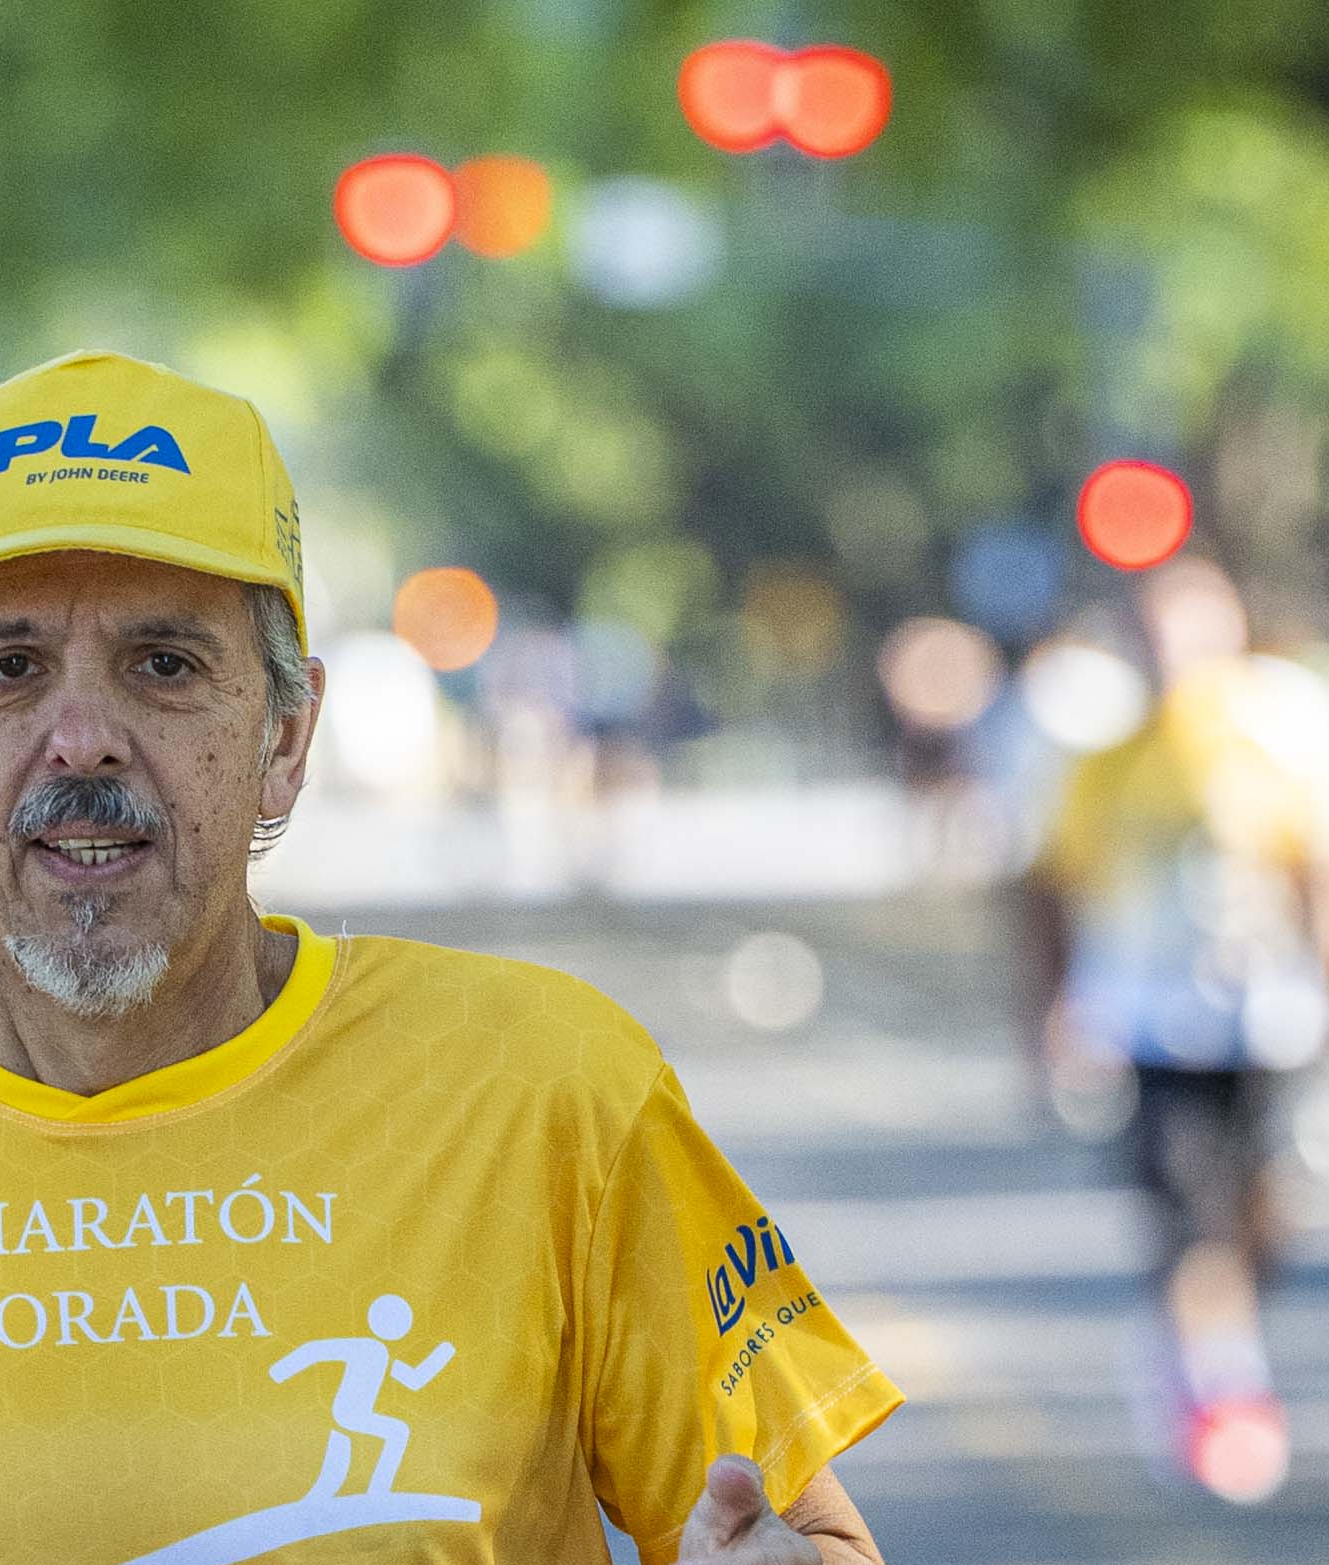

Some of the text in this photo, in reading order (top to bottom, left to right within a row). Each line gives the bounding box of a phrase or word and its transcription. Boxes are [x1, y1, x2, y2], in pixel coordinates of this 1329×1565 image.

[26, 467, 149, 485] BY JOHN DEERE
[721, 1291, 820, 1396] SABORES QUE
